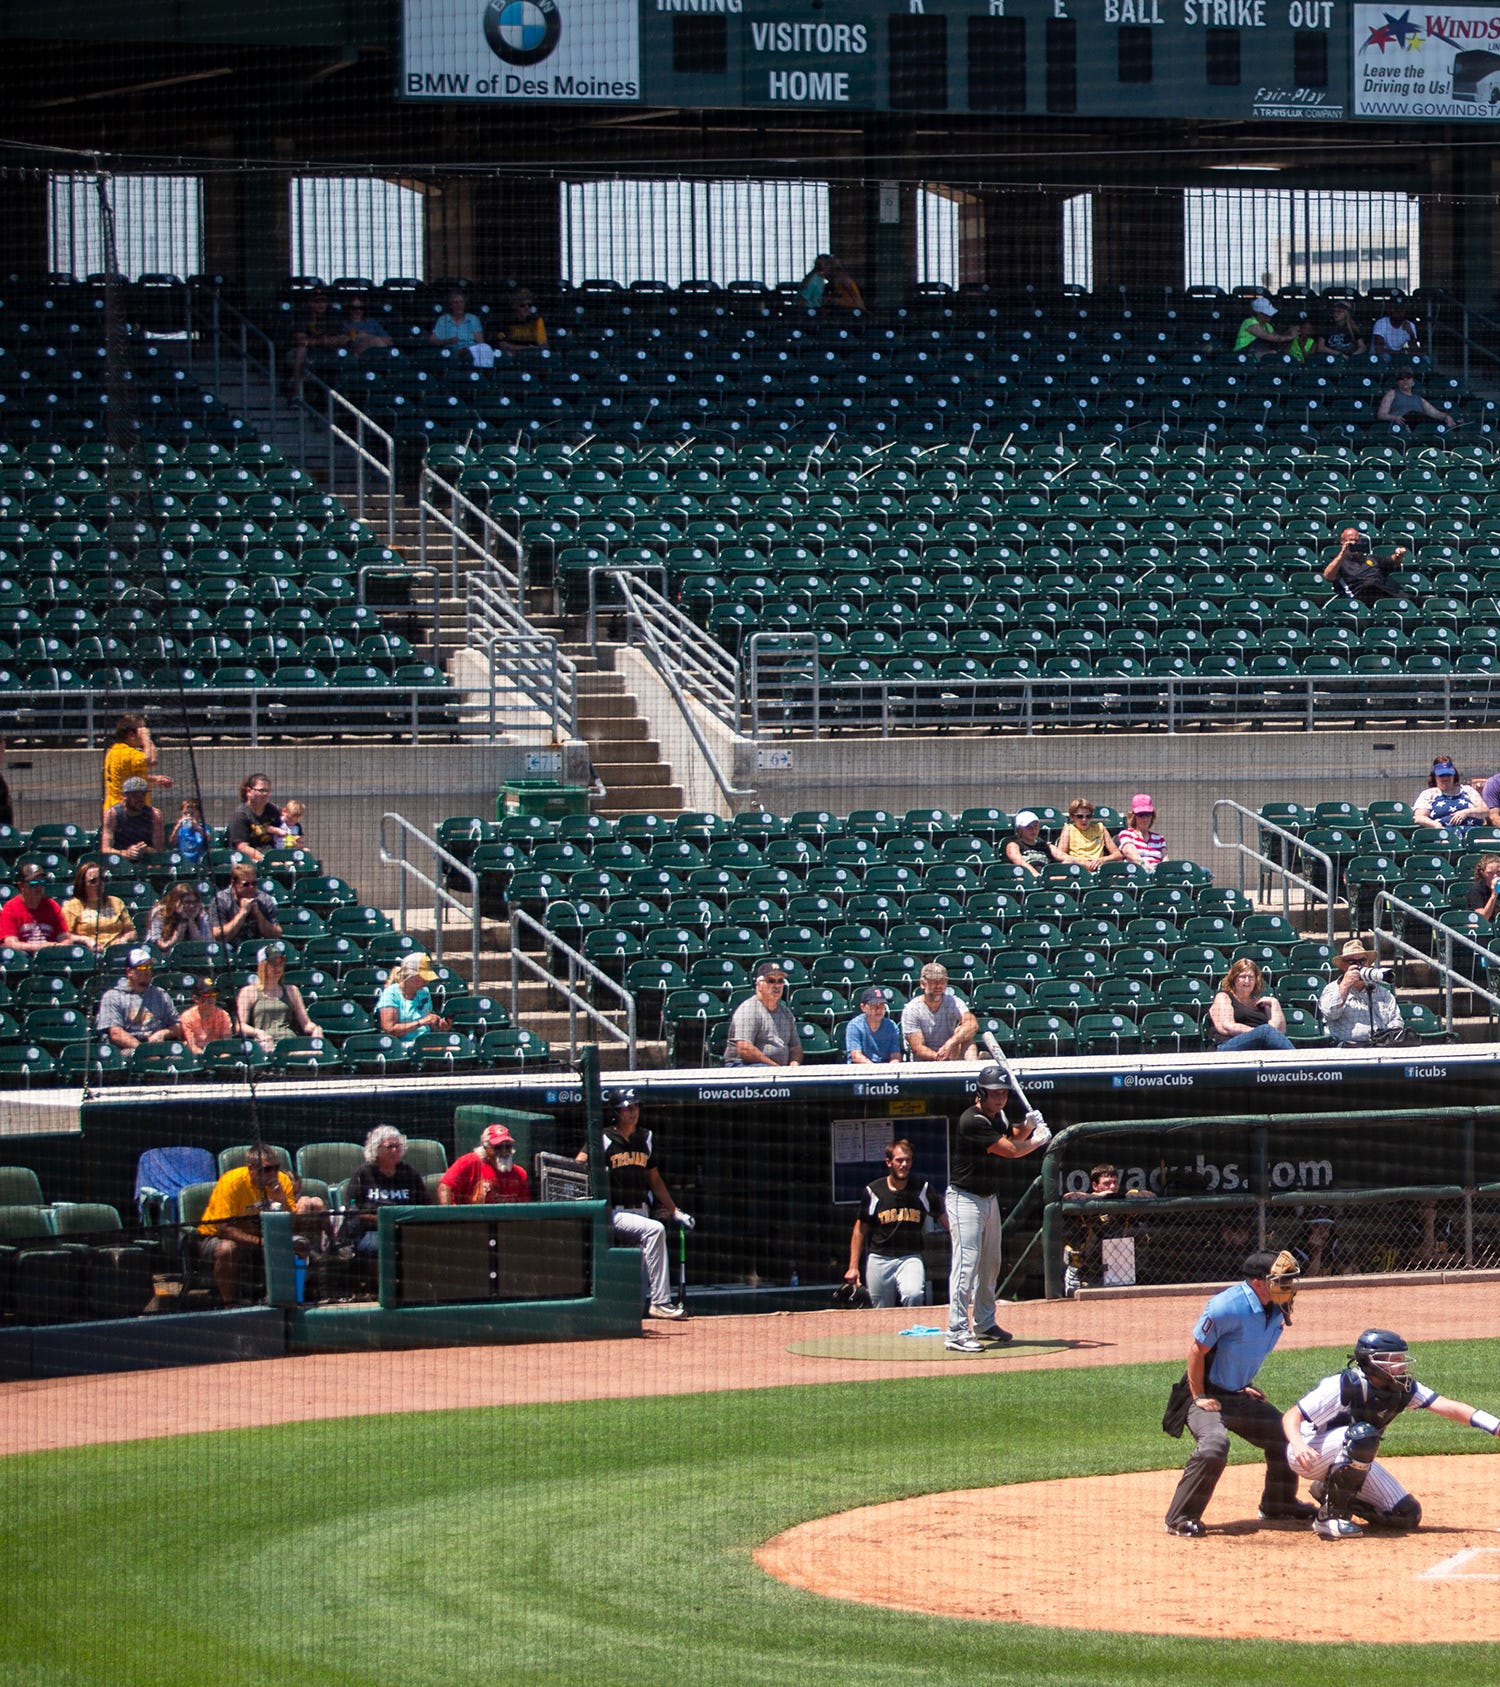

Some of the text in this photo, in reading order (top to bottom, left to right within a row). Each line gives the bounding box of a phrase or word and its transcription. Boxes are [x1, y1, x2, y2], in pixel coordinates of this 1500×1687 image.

[1105, 0, 1334, 28] BALL STRIKE OUT
[752, 22, 867, 53] VISITORS
[1364, 64, 1424, 78] Leave the
[407, 73, 637, 96] BMW of Des Moines
[769, 71, 849, 100] HOME
[1364, 79, 1450, 96] Driving to Us!
[699, 1085, 790, 1100] iowacubs.com
[865, 1083, 899, 1096] icubs
[1123, 1072, 1194, 1087] @IowaCubs
[1256, 1070, 1343, 1083] iowacubs.com
[1415, 1065, 1447, 1078] icubs
[368, 1188, 410, 1200] HOME
